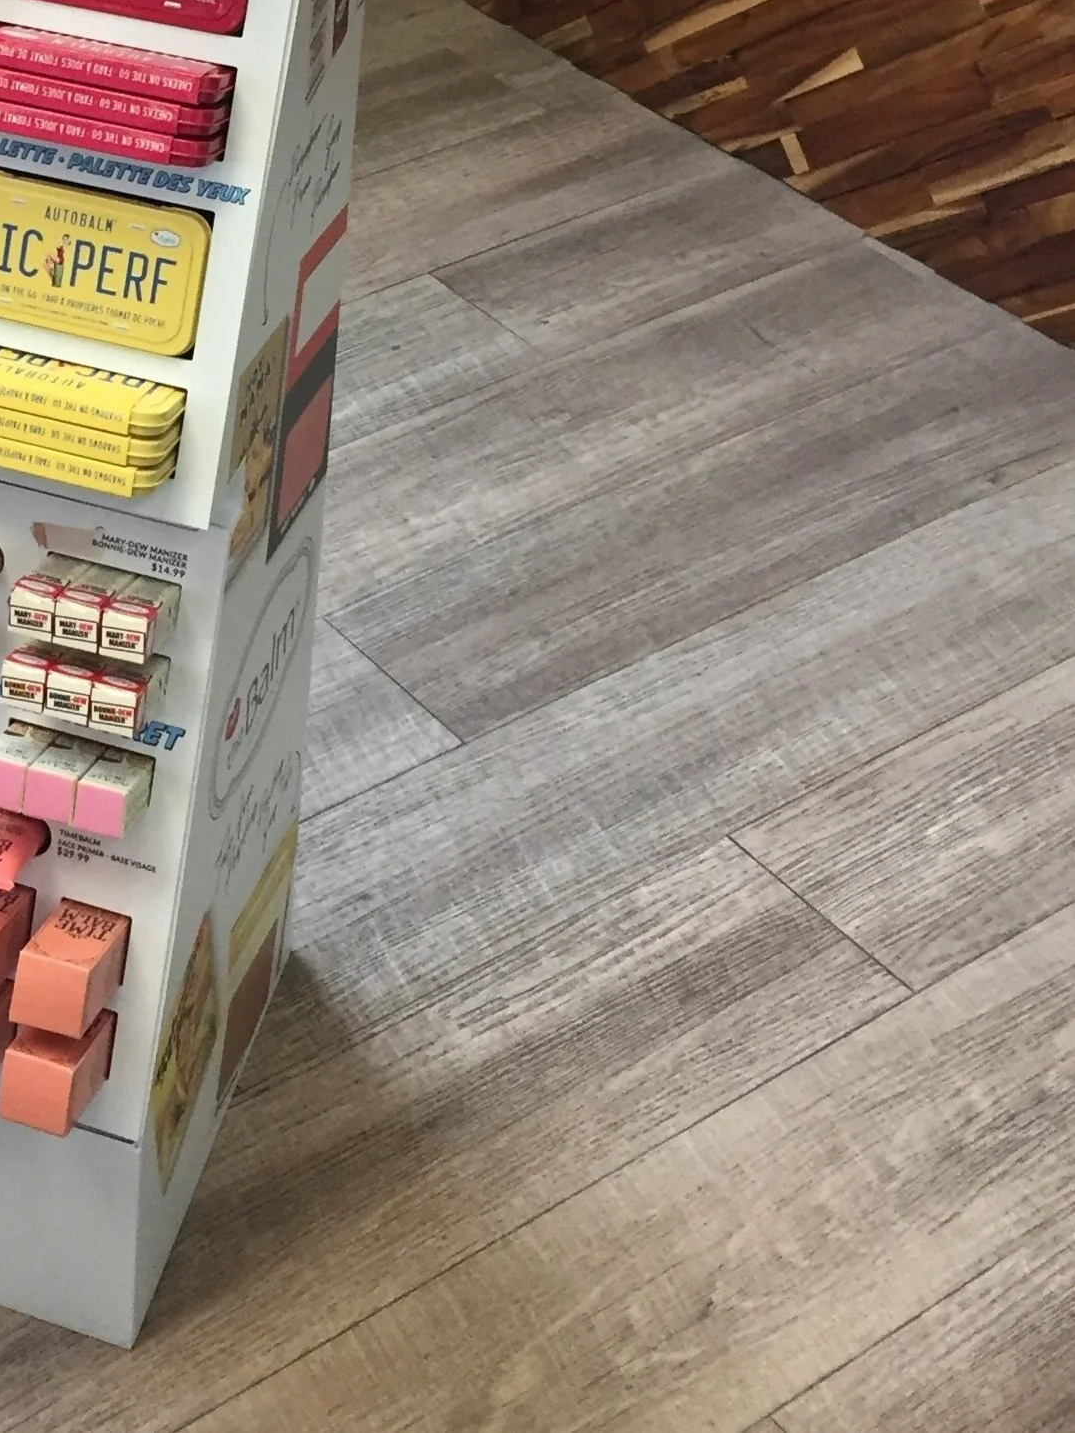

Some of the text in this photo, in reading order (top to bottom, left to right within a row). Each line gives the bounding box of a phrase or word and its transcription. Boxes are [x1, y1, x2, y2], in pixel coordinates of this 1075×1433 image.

[66, 153, 152, 186] PALETTE
[152, 170, 194, 194] DES
[196, 178, 252, 206] YEUX
[44, 205, 114, 233] AUTOBALM
[69, 240, 178, 305] PERF
[102, 533, 188, 561] MARY-DEW MANIZER
[149, 553, 187, 569] MANIZER
[152, 563, 186, 578] $14.99
[57, 846, 90, 862] $29.99
[54, 919, 111, 942] TIME
[59, 909, 118, 932] BALM
